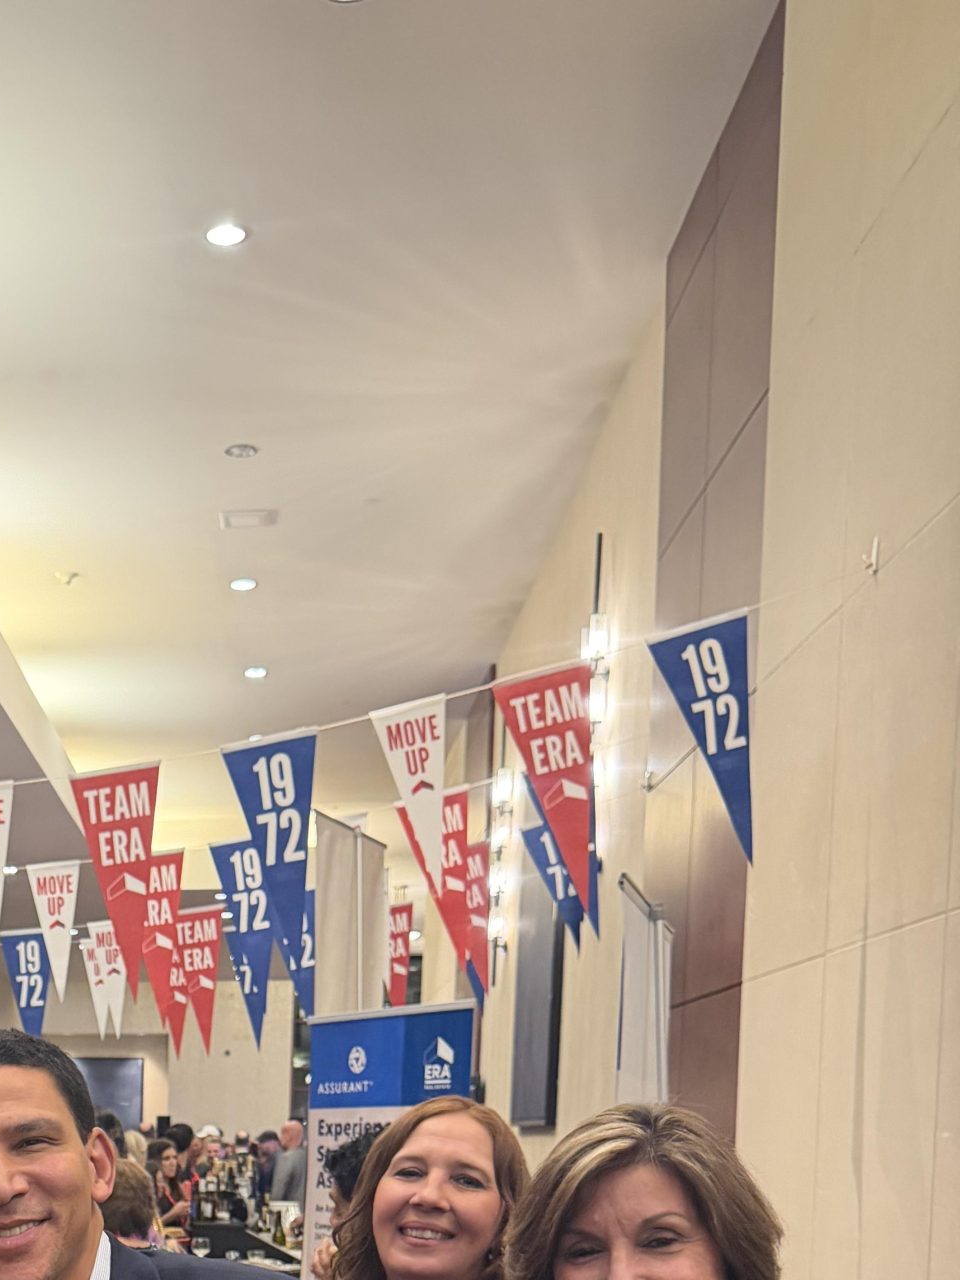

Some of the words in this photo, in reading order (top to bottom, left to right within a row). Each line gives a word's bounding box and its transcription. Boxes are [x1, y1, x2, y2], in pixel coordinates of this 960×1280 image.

[681, 637, 731, 699] 19
[508, 681, 589, 735] TEAM
[691, 693, 748, 757] 72
[385, 714, 440, 752] MOVE
[404, 747, 430, 777] UP
[529, 730, 585, 776] ERA
[252, 752, 295, 811] 19
[83, 781, 152, 826] TEAM
[98, 826, 146, 868] ERA
[255, 808, 307, 867] 72
[539, 830, 559, 865] 1
[36, 874, 74, 897] MOVE
[149, 864, 178, 894] AM
[230, 848, 262, 892] 19
[47, 896, 65, 917] UP
[144, 897, 173, 928] RA
[232, 889, 271, 934] 72
[175, 917, 218, 946] TEAM
[15, 940, 41, 974] 19
[105, 947, 120, 965] UP
[183, 947, 215, 972] ERA
[15, 974, 44, 1008] 72
[169, 966, 188, 988] RA
[317, 1079, 369, 1095] ASSURANT
[424, 1063, 451, 1080] ERA
